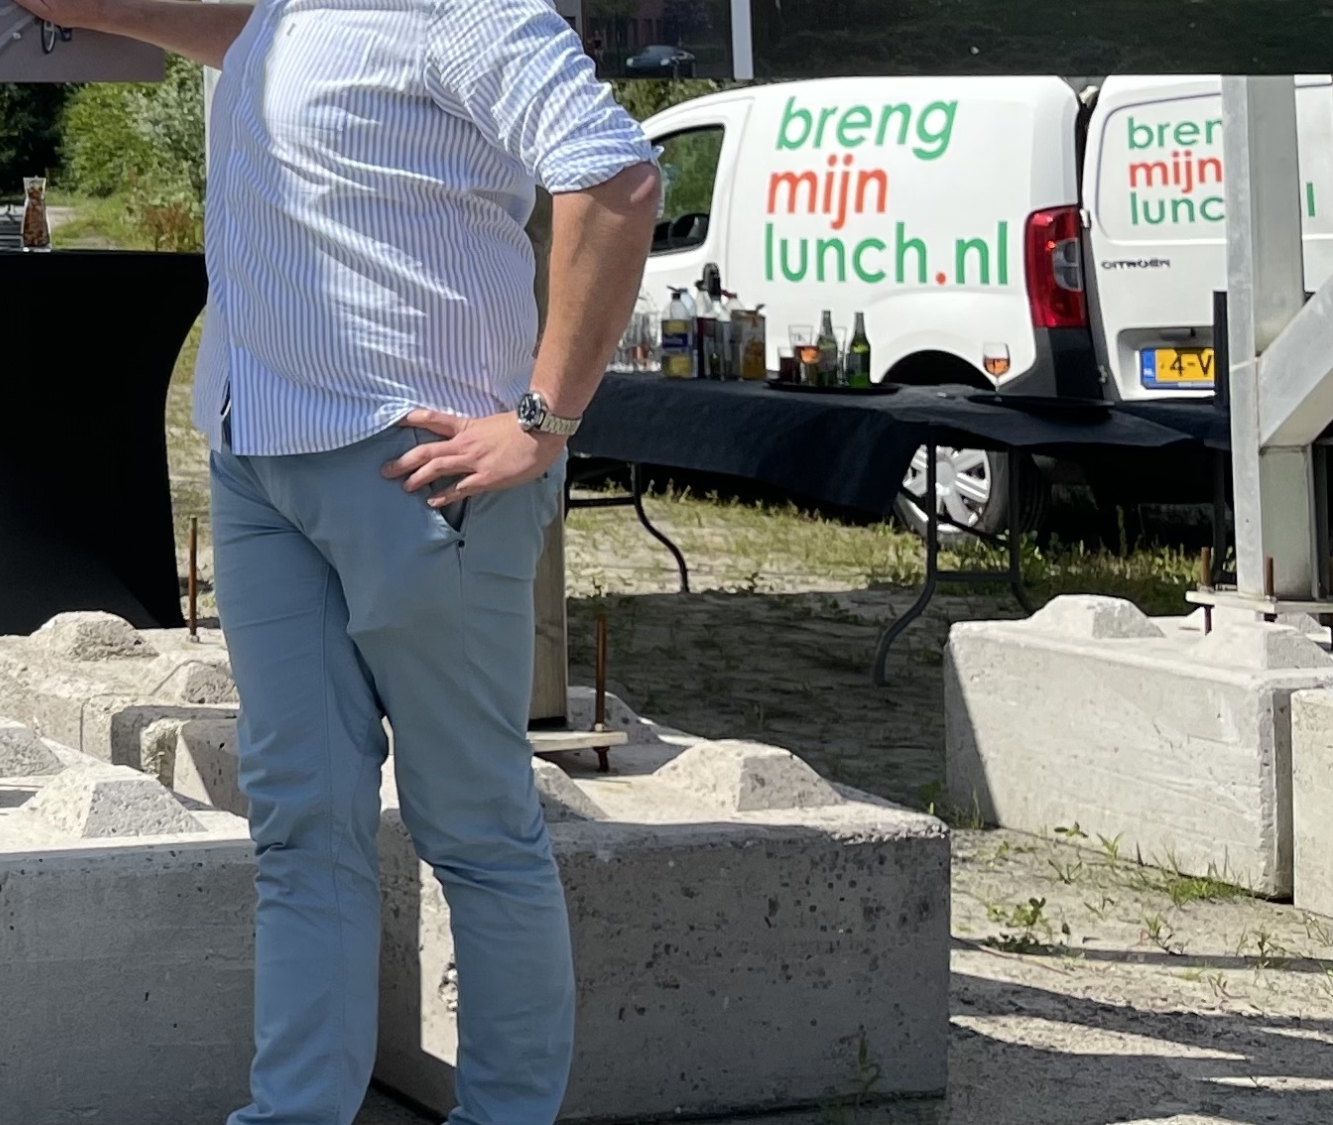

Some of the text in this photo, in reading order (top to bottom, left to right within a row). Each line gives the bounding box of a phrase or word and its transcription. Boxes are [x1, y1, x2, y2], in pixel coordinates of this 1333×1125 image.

[775, 96, 958, 161] breng
[1127, 117, 1223, 149] bren
[767, 154, 888, 230] mijn
[1129, 150, 1223, 193] mijn
[765, 221, 1008, 285] lunch.nl
